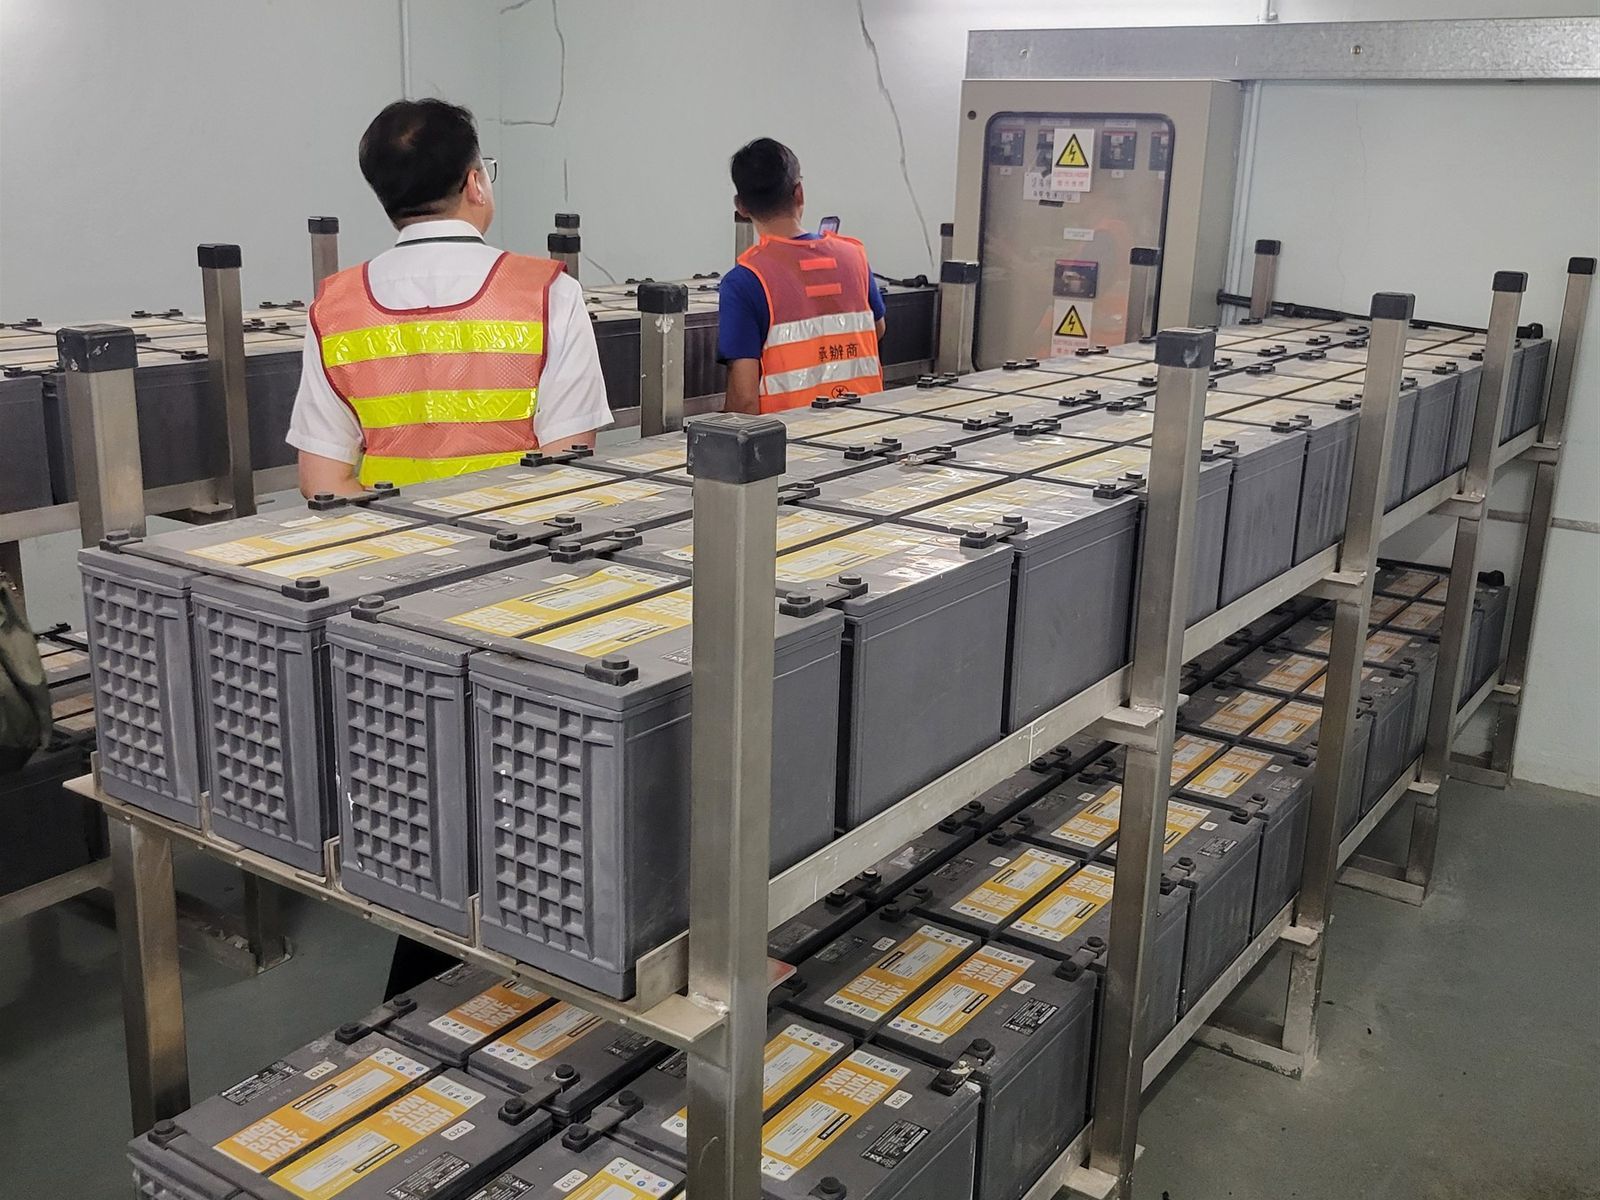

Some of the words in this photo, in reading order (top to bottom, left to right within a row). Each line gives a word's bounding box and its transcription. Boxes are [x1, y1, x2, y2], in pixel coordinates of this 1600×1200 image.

[819, 343, 858, 361] 承辦商
[956, 958, 988, 977] MAX
[971, 963, 1003, 982] RATE
[986, 968, 1018, 988] HIGH
[844, 974, 877, 995] HIGH
[859, 979, 892, 1000] RATE
[877, 984, 908, 1006] MAX
[455, 993, 496, 1016] HIGH
[469, 999, 509, 1021] RATE
[481, 1005, 522, 1027] MAX
[310, 1065, 330, 1077] 11D
[820, 1066, 857, 1092] MAX
[835, 1072, 873, 1099] RATE
[852, 1079, 890, 1106] HIGH
[380, 1093, 427, 1121] MAX
[395, 1101, 440, 1128] RATE
[230, 1117, 282, 1146] HIGH
[408, 1107, 455, 1136] HIGH
[447, 1125, 468, 1138] 12D
[244, 1124, 295, 1153] RATE
[257, 1131, 310, 1161] MAX
[561, 1176, 581, 1188] 33D
